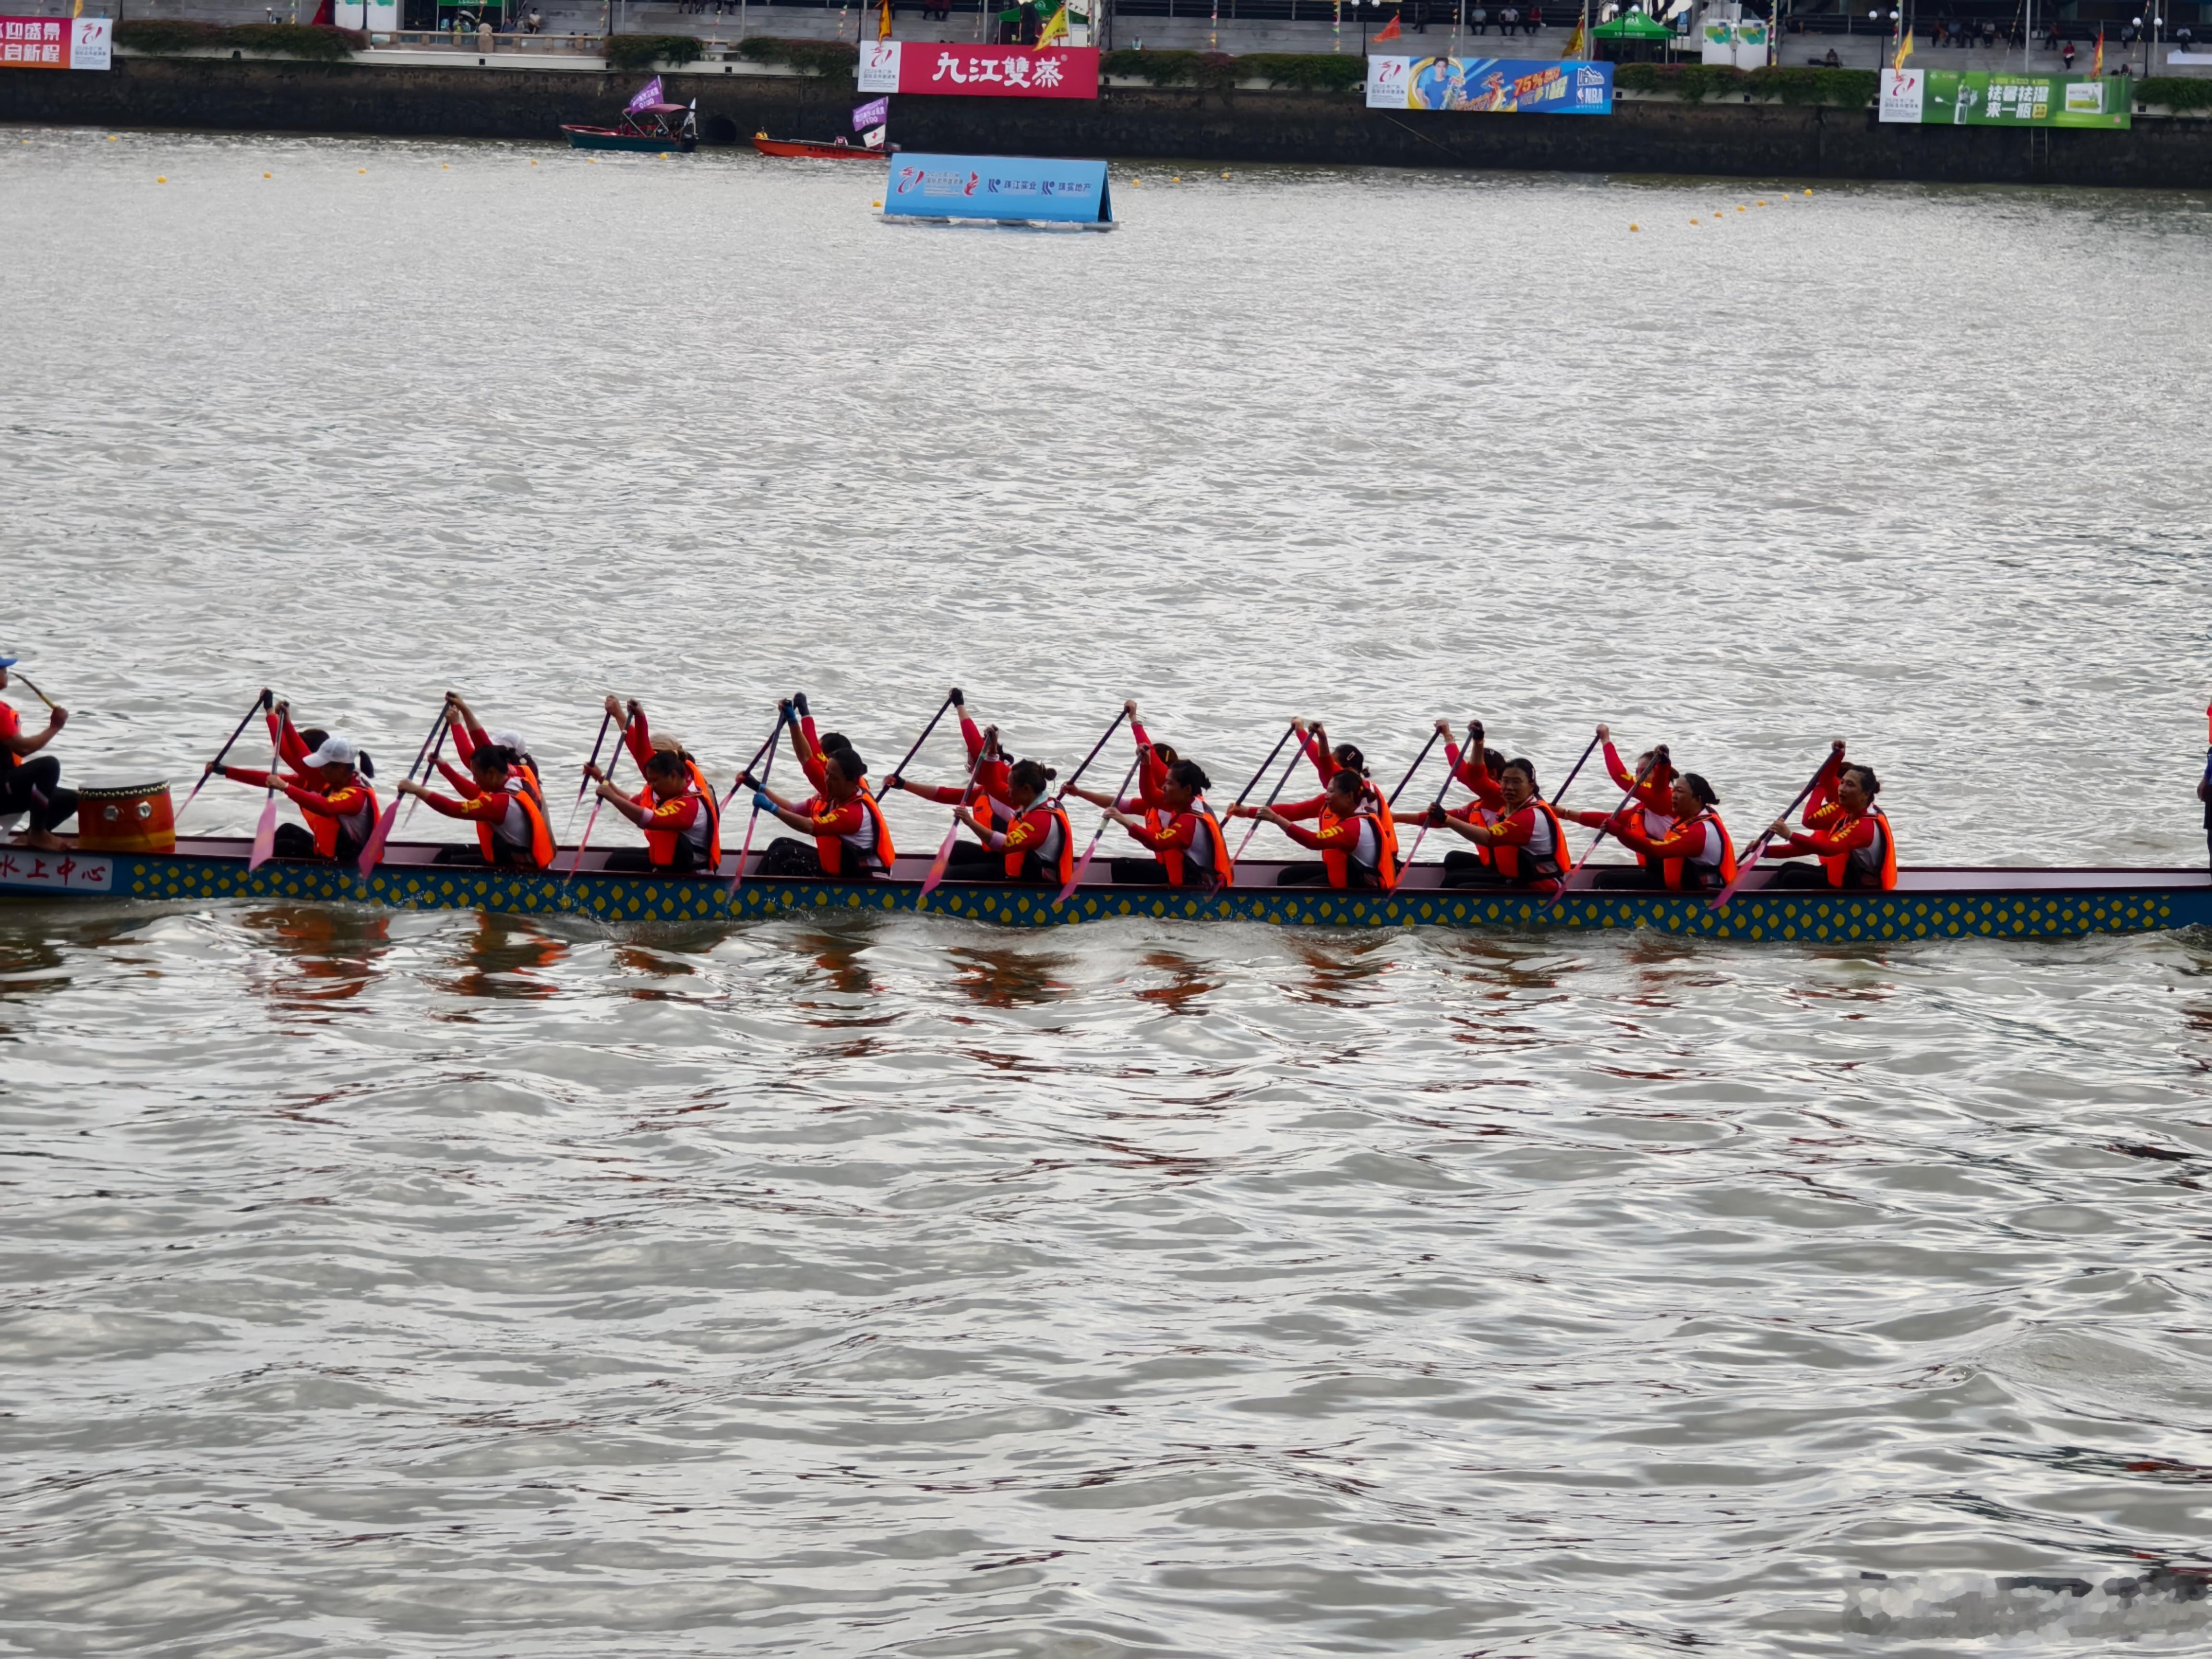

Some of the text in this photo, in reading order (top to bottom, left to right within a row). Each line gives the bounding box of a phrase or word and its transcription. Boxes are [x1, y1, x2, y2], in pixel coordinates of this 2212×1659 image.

[932, 52, 1064, 88] 九江雙蒸
[1514, 72, 1544, 97] 75%
[1586, 88, 1603, 104] NBA
[1985, 101, 2032, 119] 来一瓶
[0, 854, 106, 886] 水上中心
